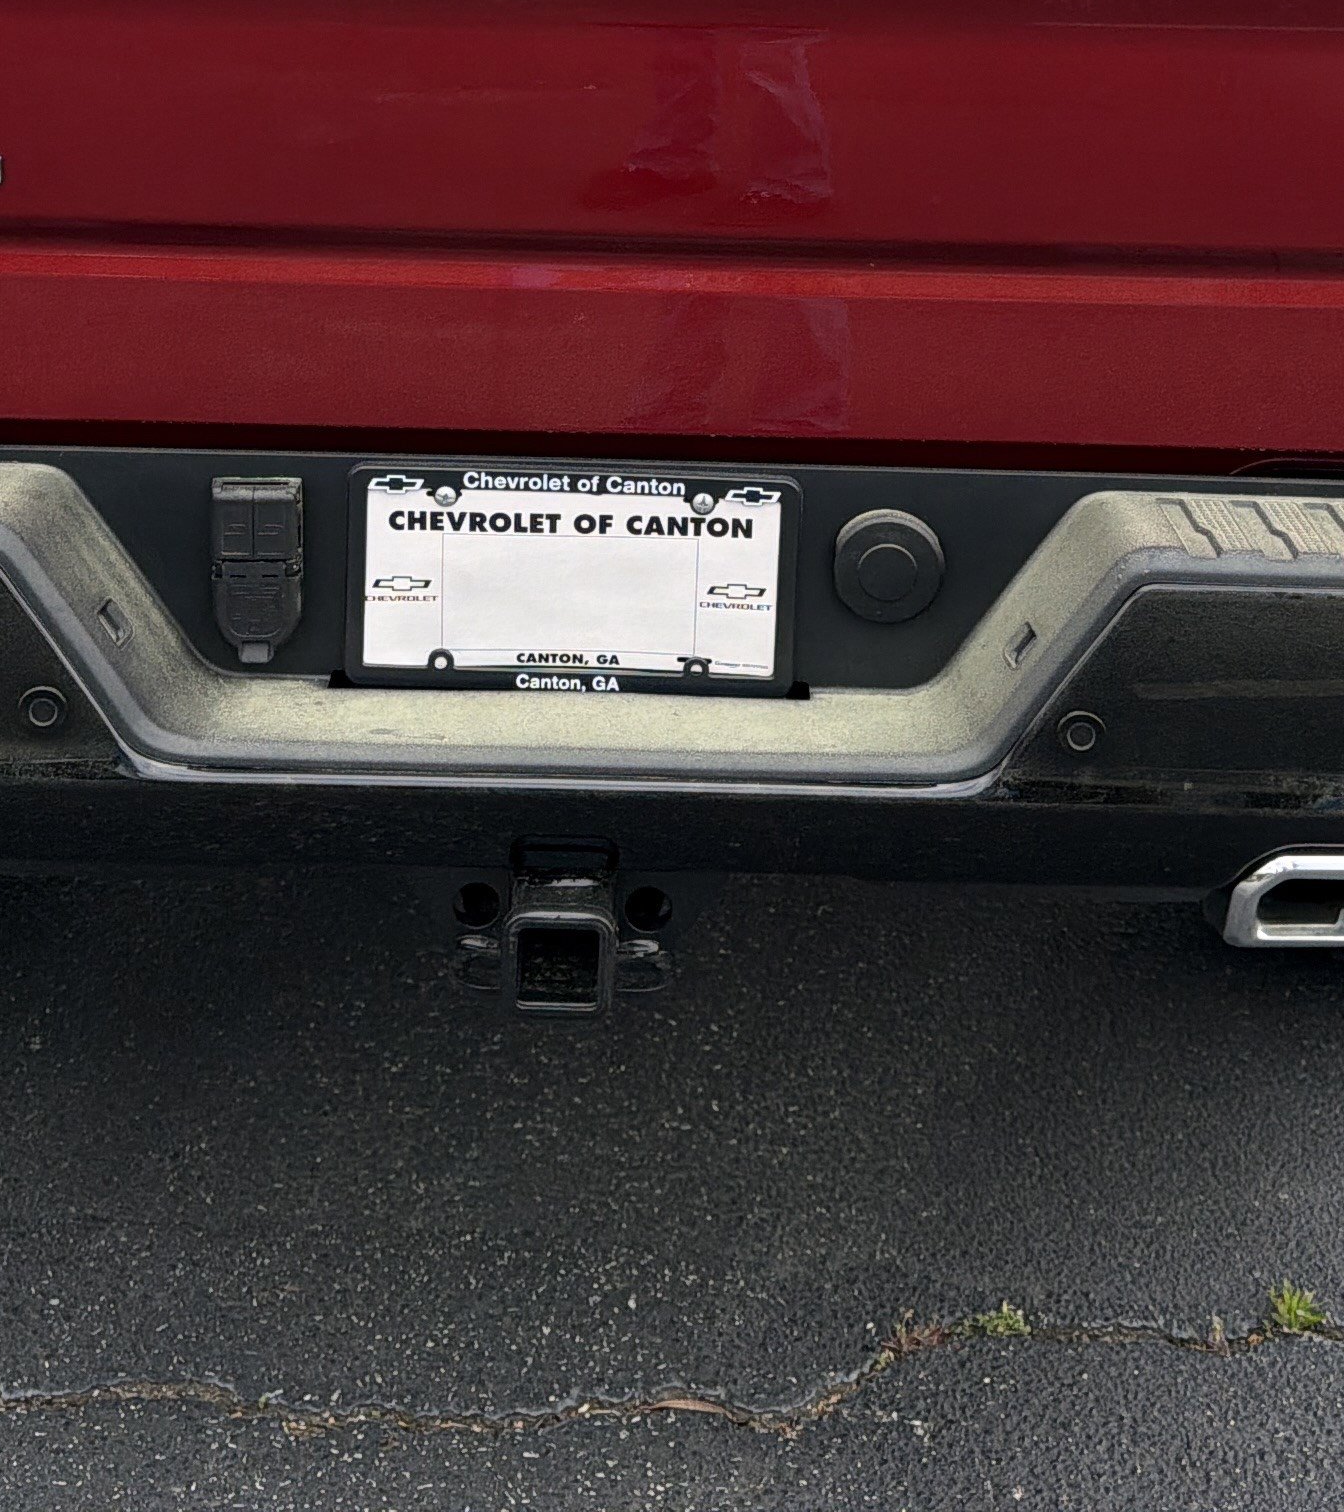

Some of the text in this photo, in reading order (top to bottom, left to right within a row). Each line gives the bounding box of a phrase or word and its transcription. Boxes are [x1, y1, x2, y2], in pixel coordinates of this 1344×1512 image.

[463, 471, 686, 496] Chevrolet of Canton
[388, 510, 753, 539] CHEVROLET OF CANTON
[699, 601, 773, 611] CHEVROLET
[516, 653, 620, 666] CANTON, GA
[516, 673, 620, 692] Canton, GA
